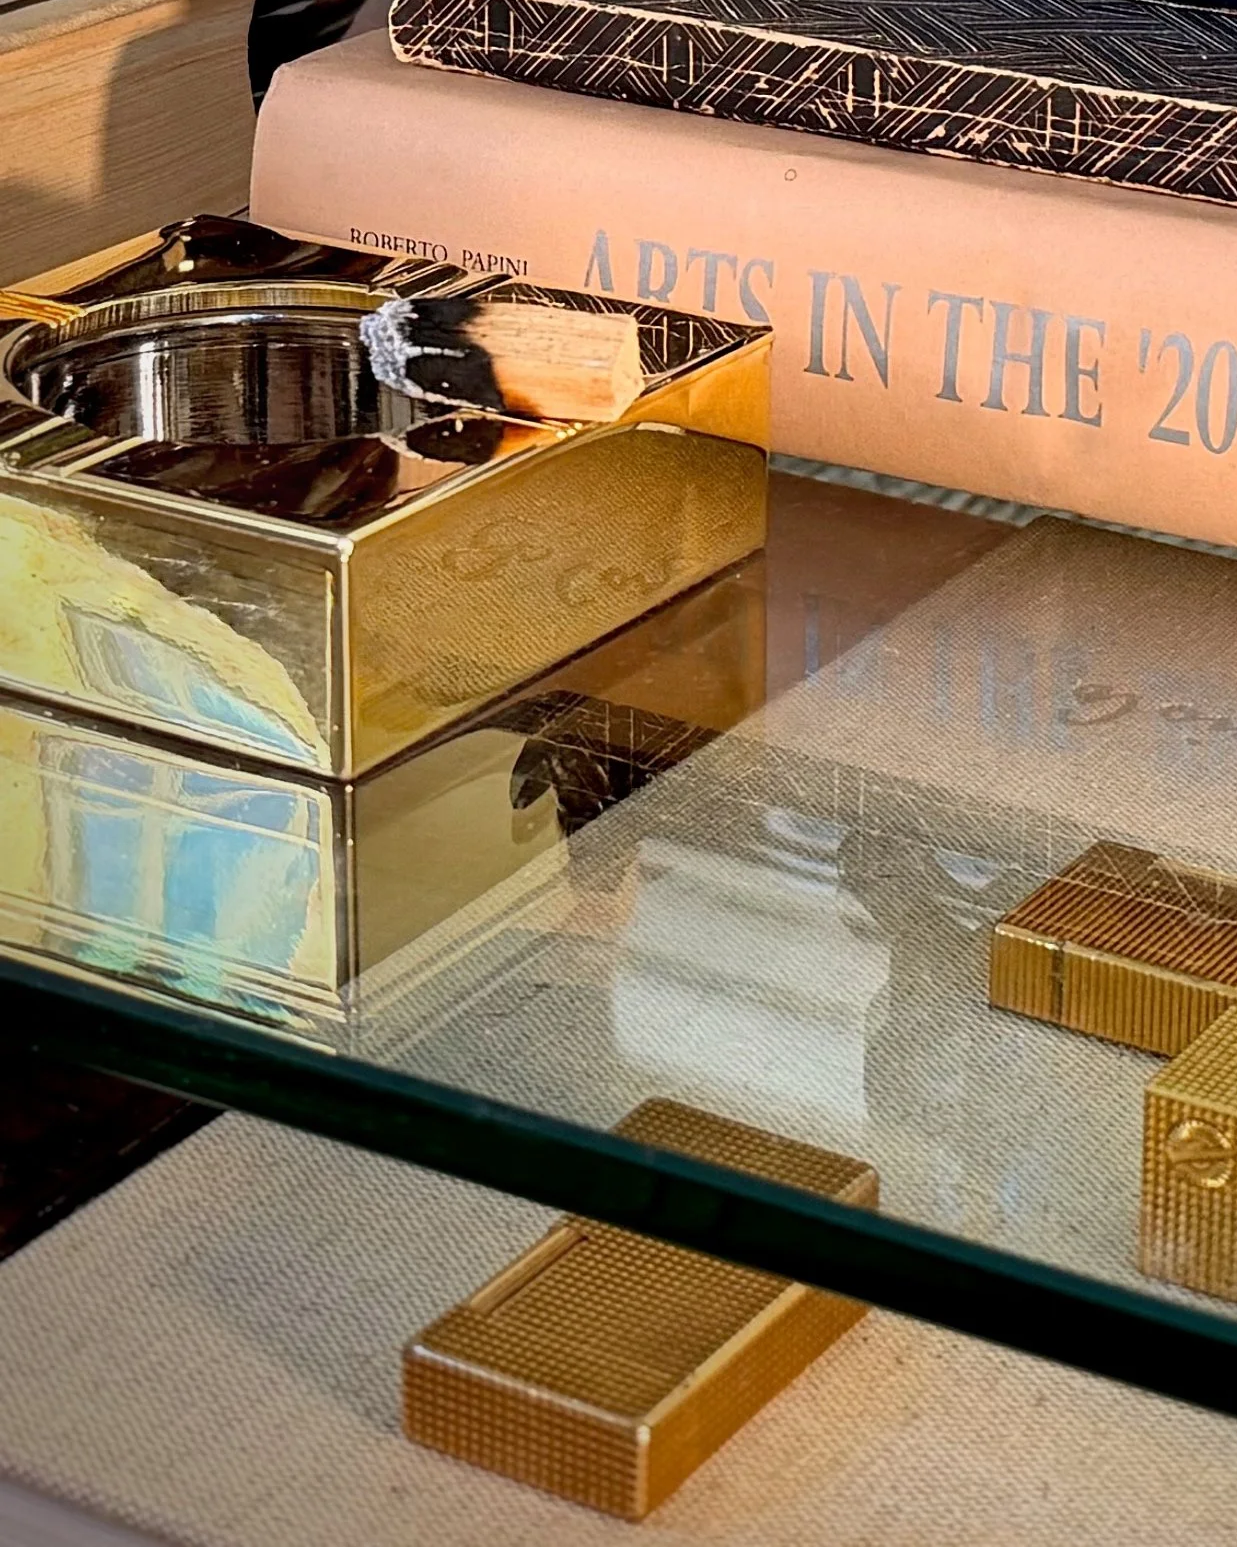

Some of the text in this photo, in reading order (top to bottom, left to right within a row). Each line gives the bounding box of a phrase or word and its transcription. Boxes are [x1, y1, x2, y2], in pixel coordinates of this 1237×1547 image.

[350, 227, 528, 276] ROBERTO PAPINI
[583, 228, 775, 323] ARTS
[803, 269, 901, 389] IN
[927, 289, 1105, 428] THE
